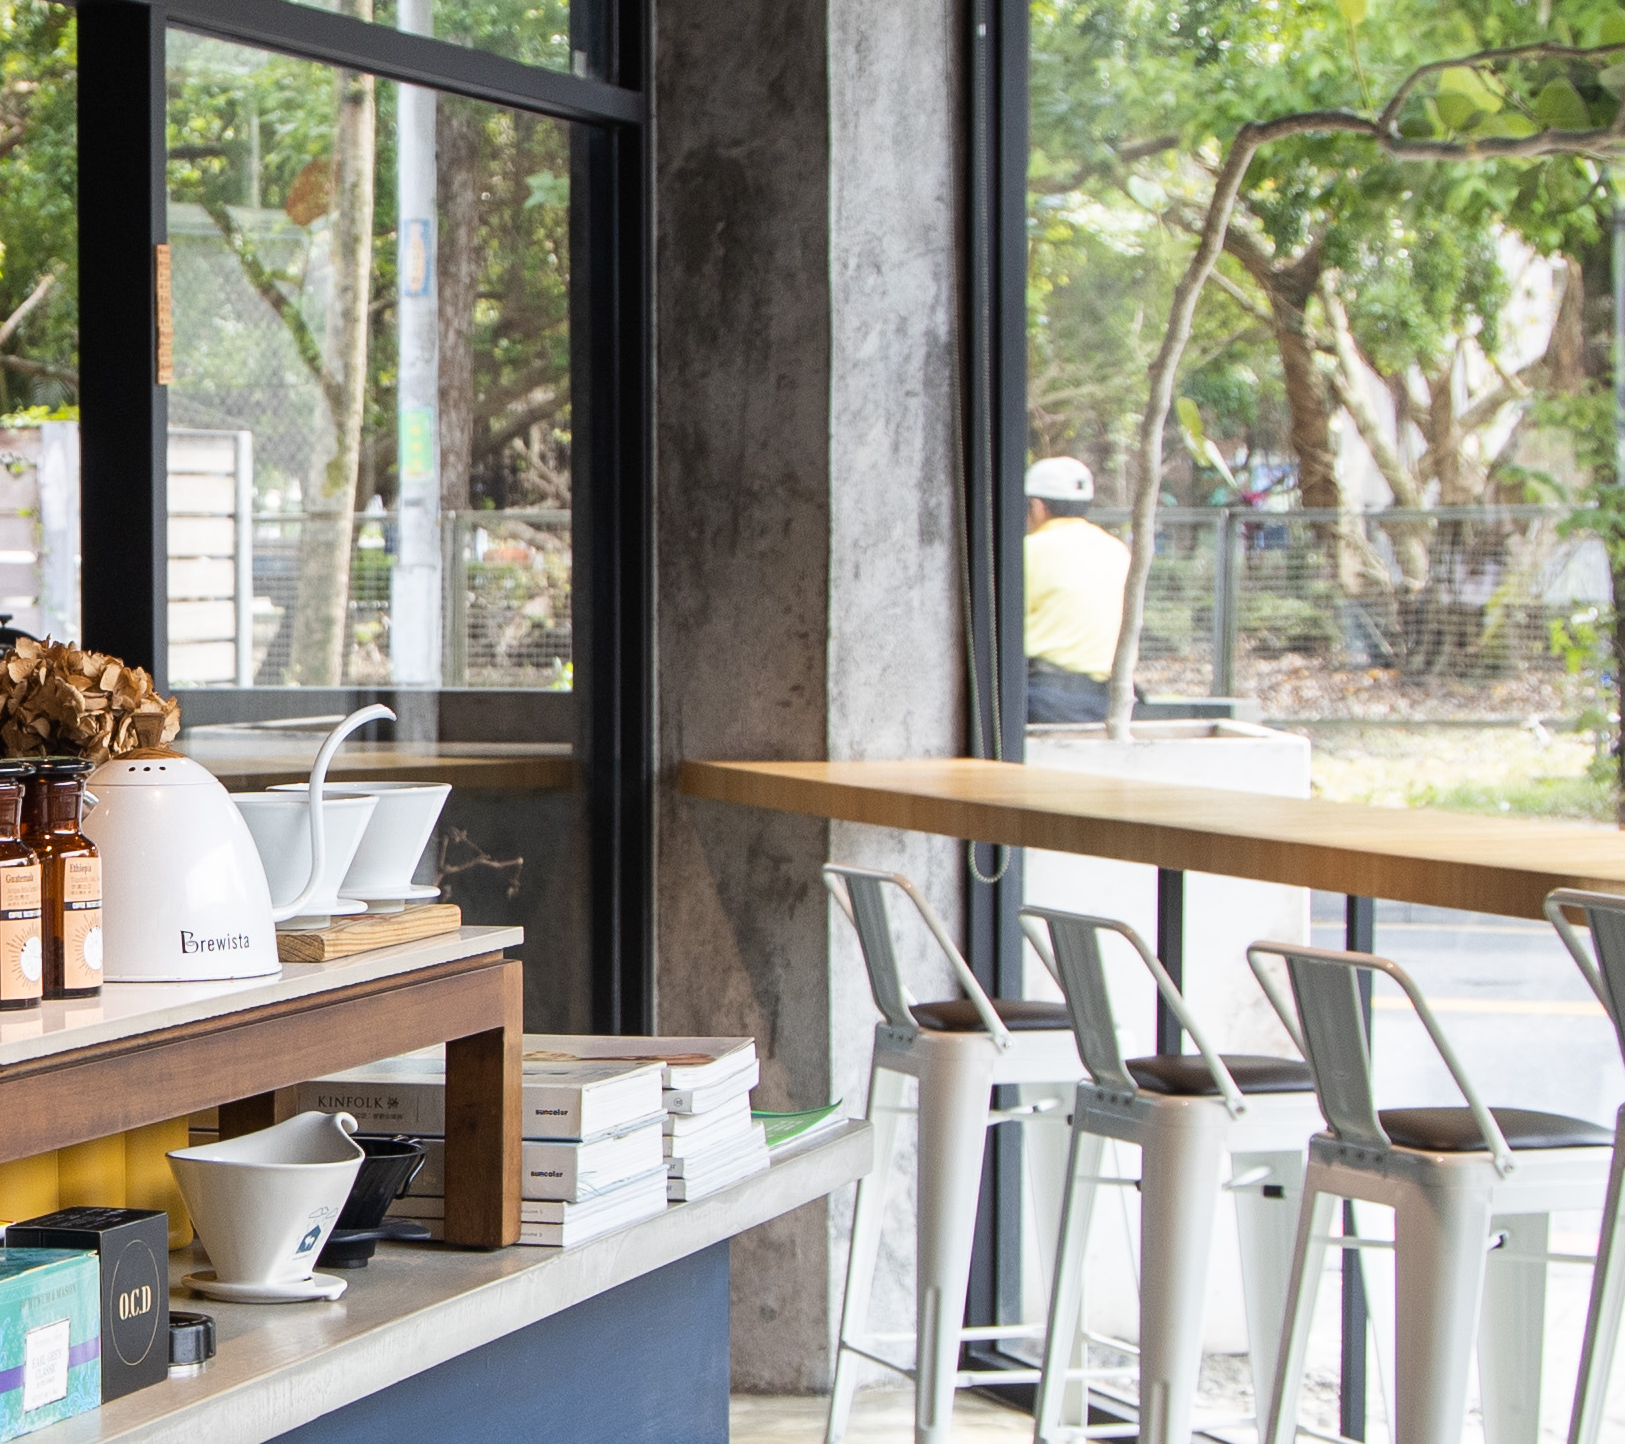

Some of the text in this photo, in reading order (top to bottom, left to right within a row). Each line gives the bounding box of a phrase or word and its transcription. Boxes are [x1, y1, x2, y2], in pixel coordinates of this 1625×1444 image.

[180, 930, 250, 954] Brewista
[317, 1095, 383, 1110] KINFOLK
[119, 1284, 152, 1321] O.C.D
